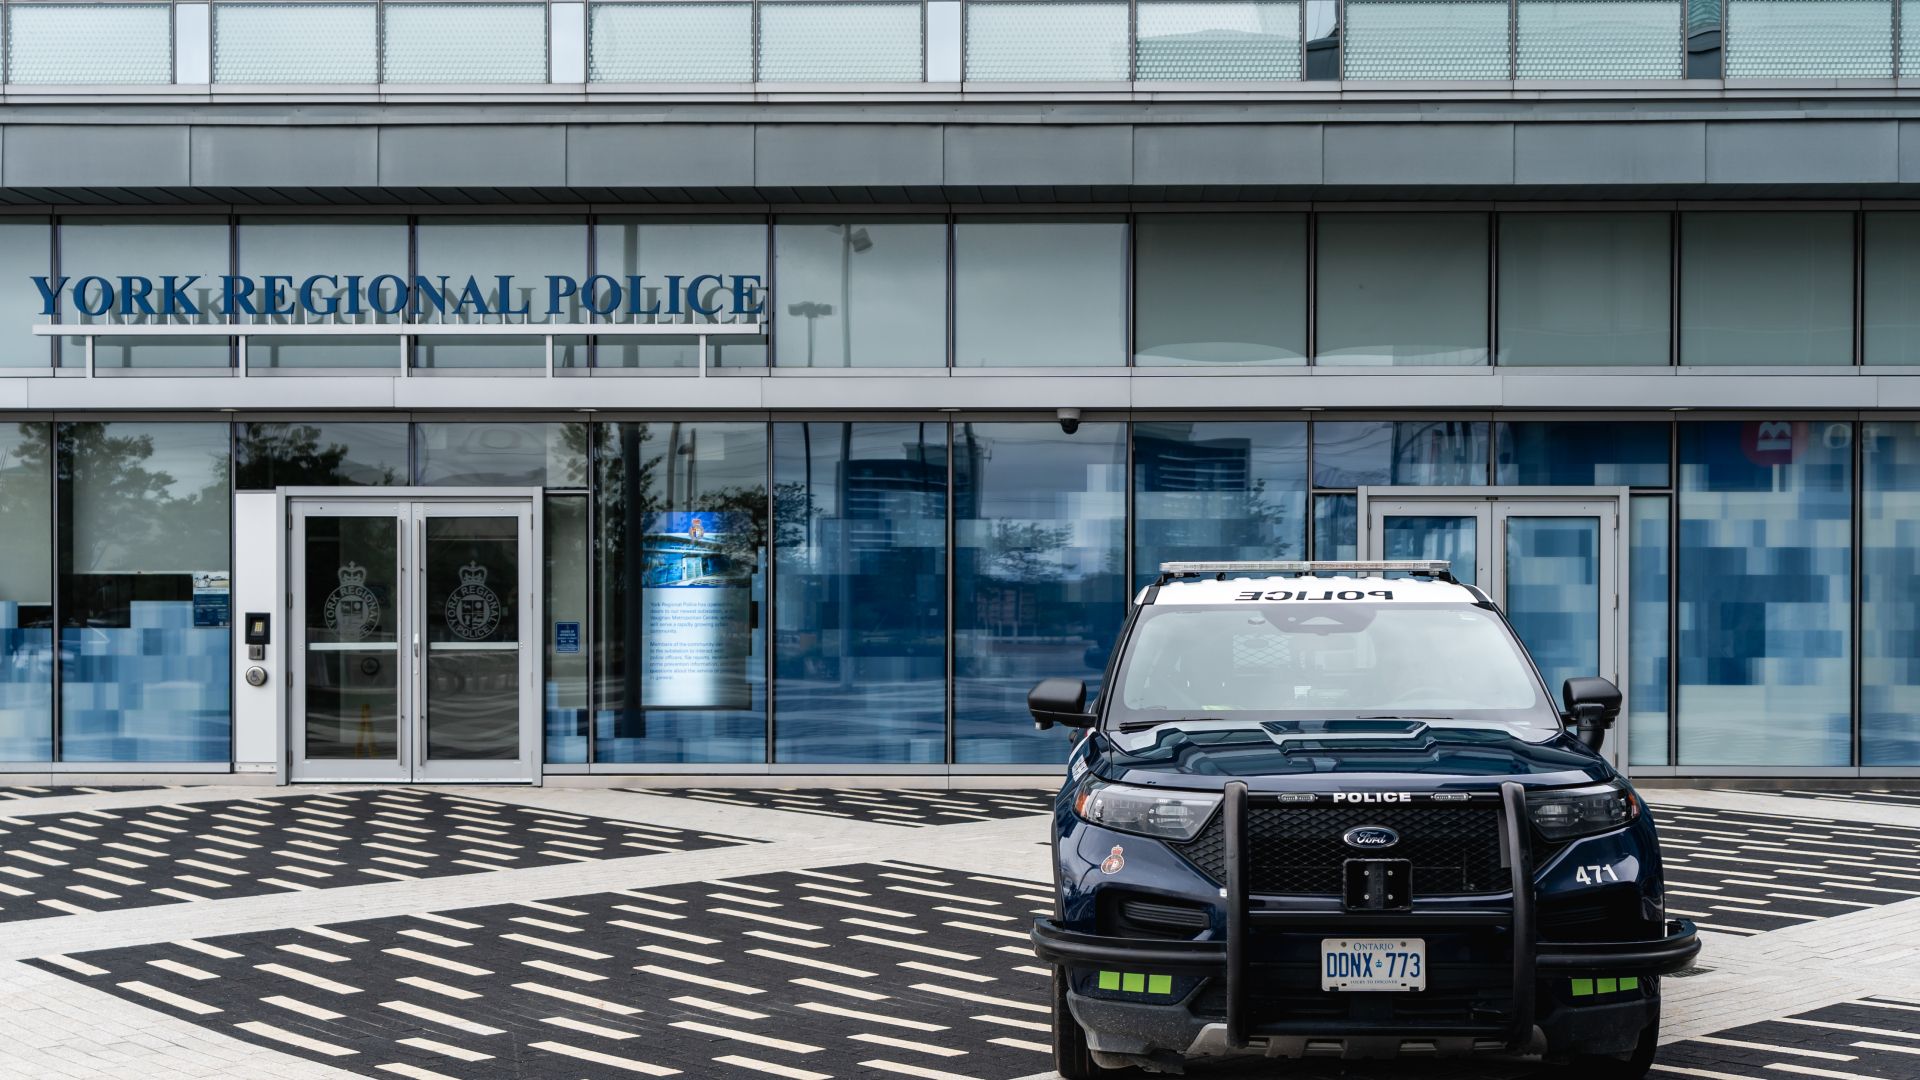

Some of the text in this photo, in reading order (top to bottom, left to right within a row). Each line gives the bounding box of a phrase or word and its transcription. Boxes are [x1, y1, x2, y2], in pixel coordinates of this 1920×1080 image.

[29, 274, 764, 316] YORK REGIONAL POLICE
[326, 585, 379, 627] YORK REGIONAL
[447, 585, 499, 627] YORK REGIONAL
[455, 623, 491, 638] POLICE
[1333, 792, 1412, 803] POLICE
[1356, 831, 1387, 844] Ford
[1576, 863, 1619, 885] 471
[1326, 952, 1421, 978] DDNX 773
